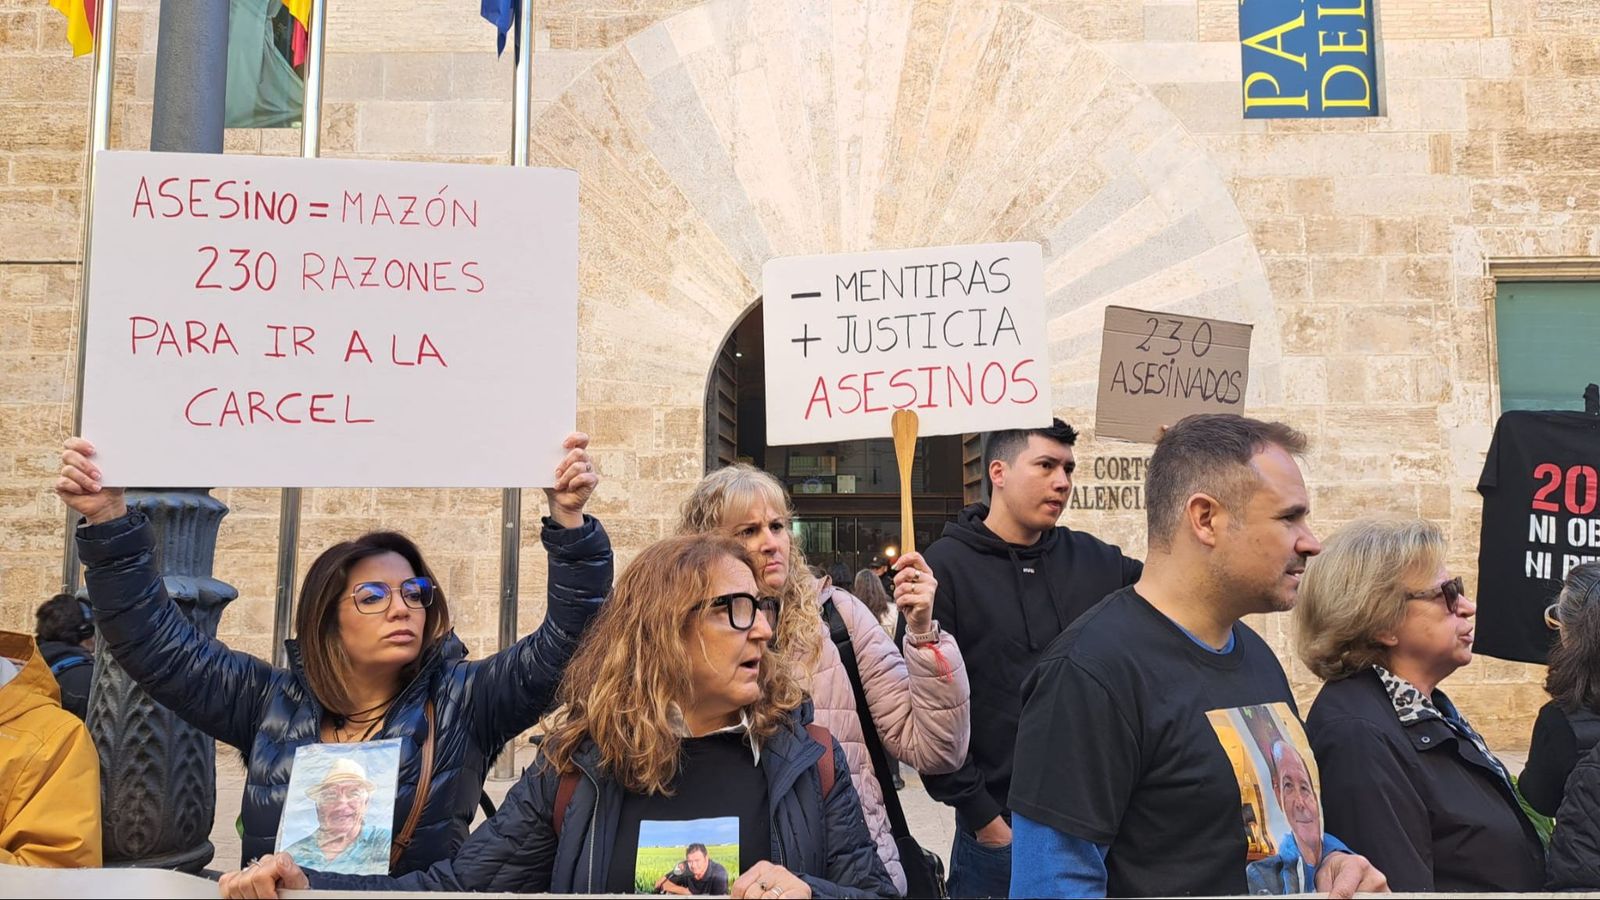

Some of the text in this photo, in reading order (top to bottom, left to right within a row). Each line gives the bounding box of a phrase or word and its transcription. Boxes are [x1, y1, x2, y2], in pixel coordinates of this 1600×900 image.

[1241, 0, 1309, 113] PA
[342, 185, 477, 228] MAZÓN
[195, 246, 485, 293] 230 RAZONES
[836, 257, 1011, 302] MENTIRAS
[130, 316, 448, 367] PARA IR A LA
[837, 306, 1021, 354] JUSTICIA
[1136, 317, 1212, 357] 230
[185, 388, 375, 427] CARCEL
[804, 358, 1039, 420] ASESINOS
[1069, 486, 1147, 510] ALENCI
[1532, 463, 1598, 515] 20
[1528, 514, 1556, 545] NI
[1525, 550, 1552, 579] NI
